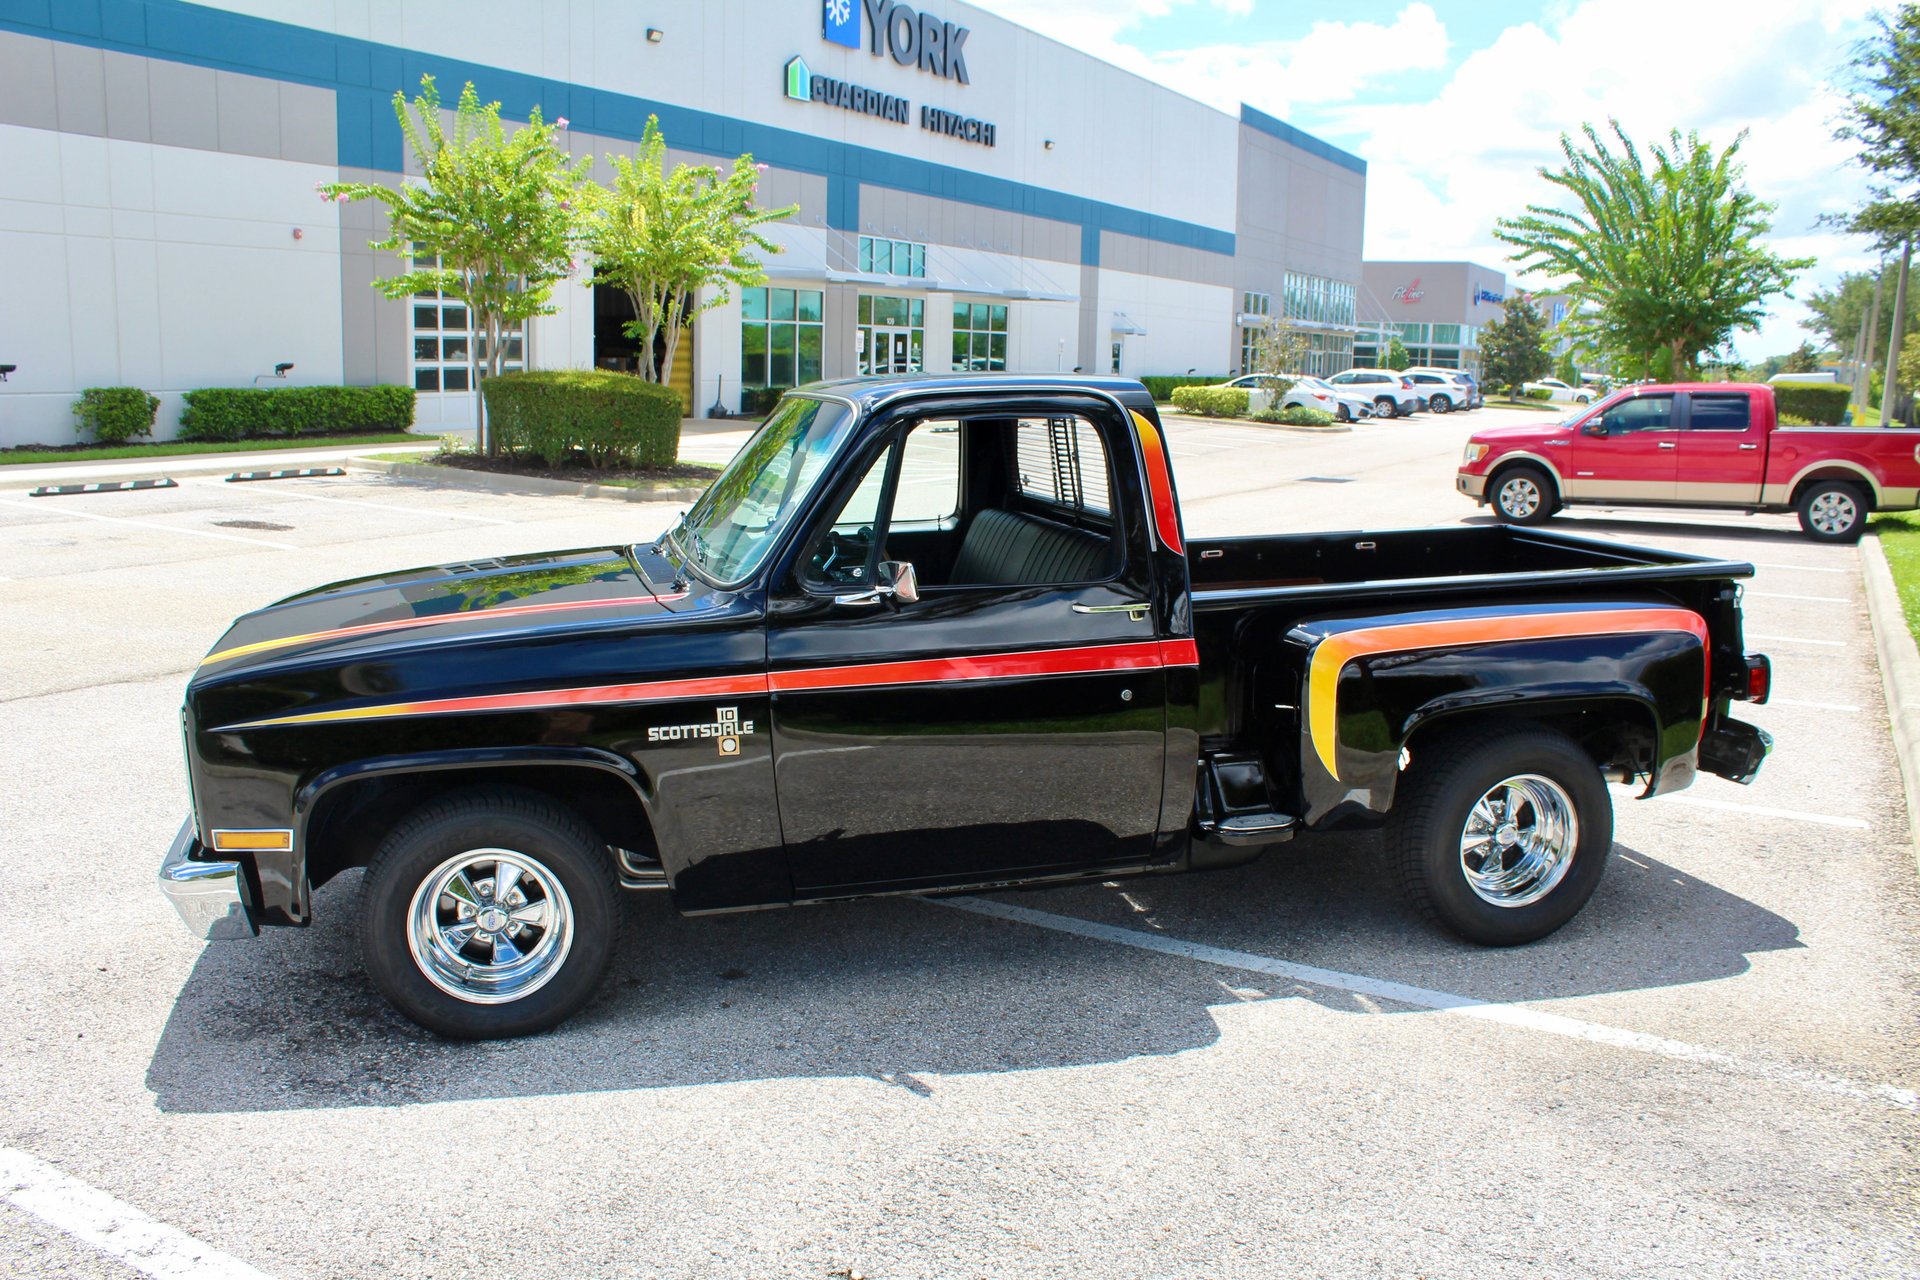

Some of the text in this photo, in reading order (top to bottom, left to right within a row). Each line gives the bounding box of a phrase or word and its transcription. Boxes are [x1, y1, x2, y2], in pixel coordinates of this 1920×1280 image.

[864, 0, 969, 85] YORK
[810, 74, 909, 124] GUARDIAN
[921, 105, 996, 147] HITACHI
[648, 720, 753, 741] SCOTTSDALE
[719, 708, 736, 721] 10
